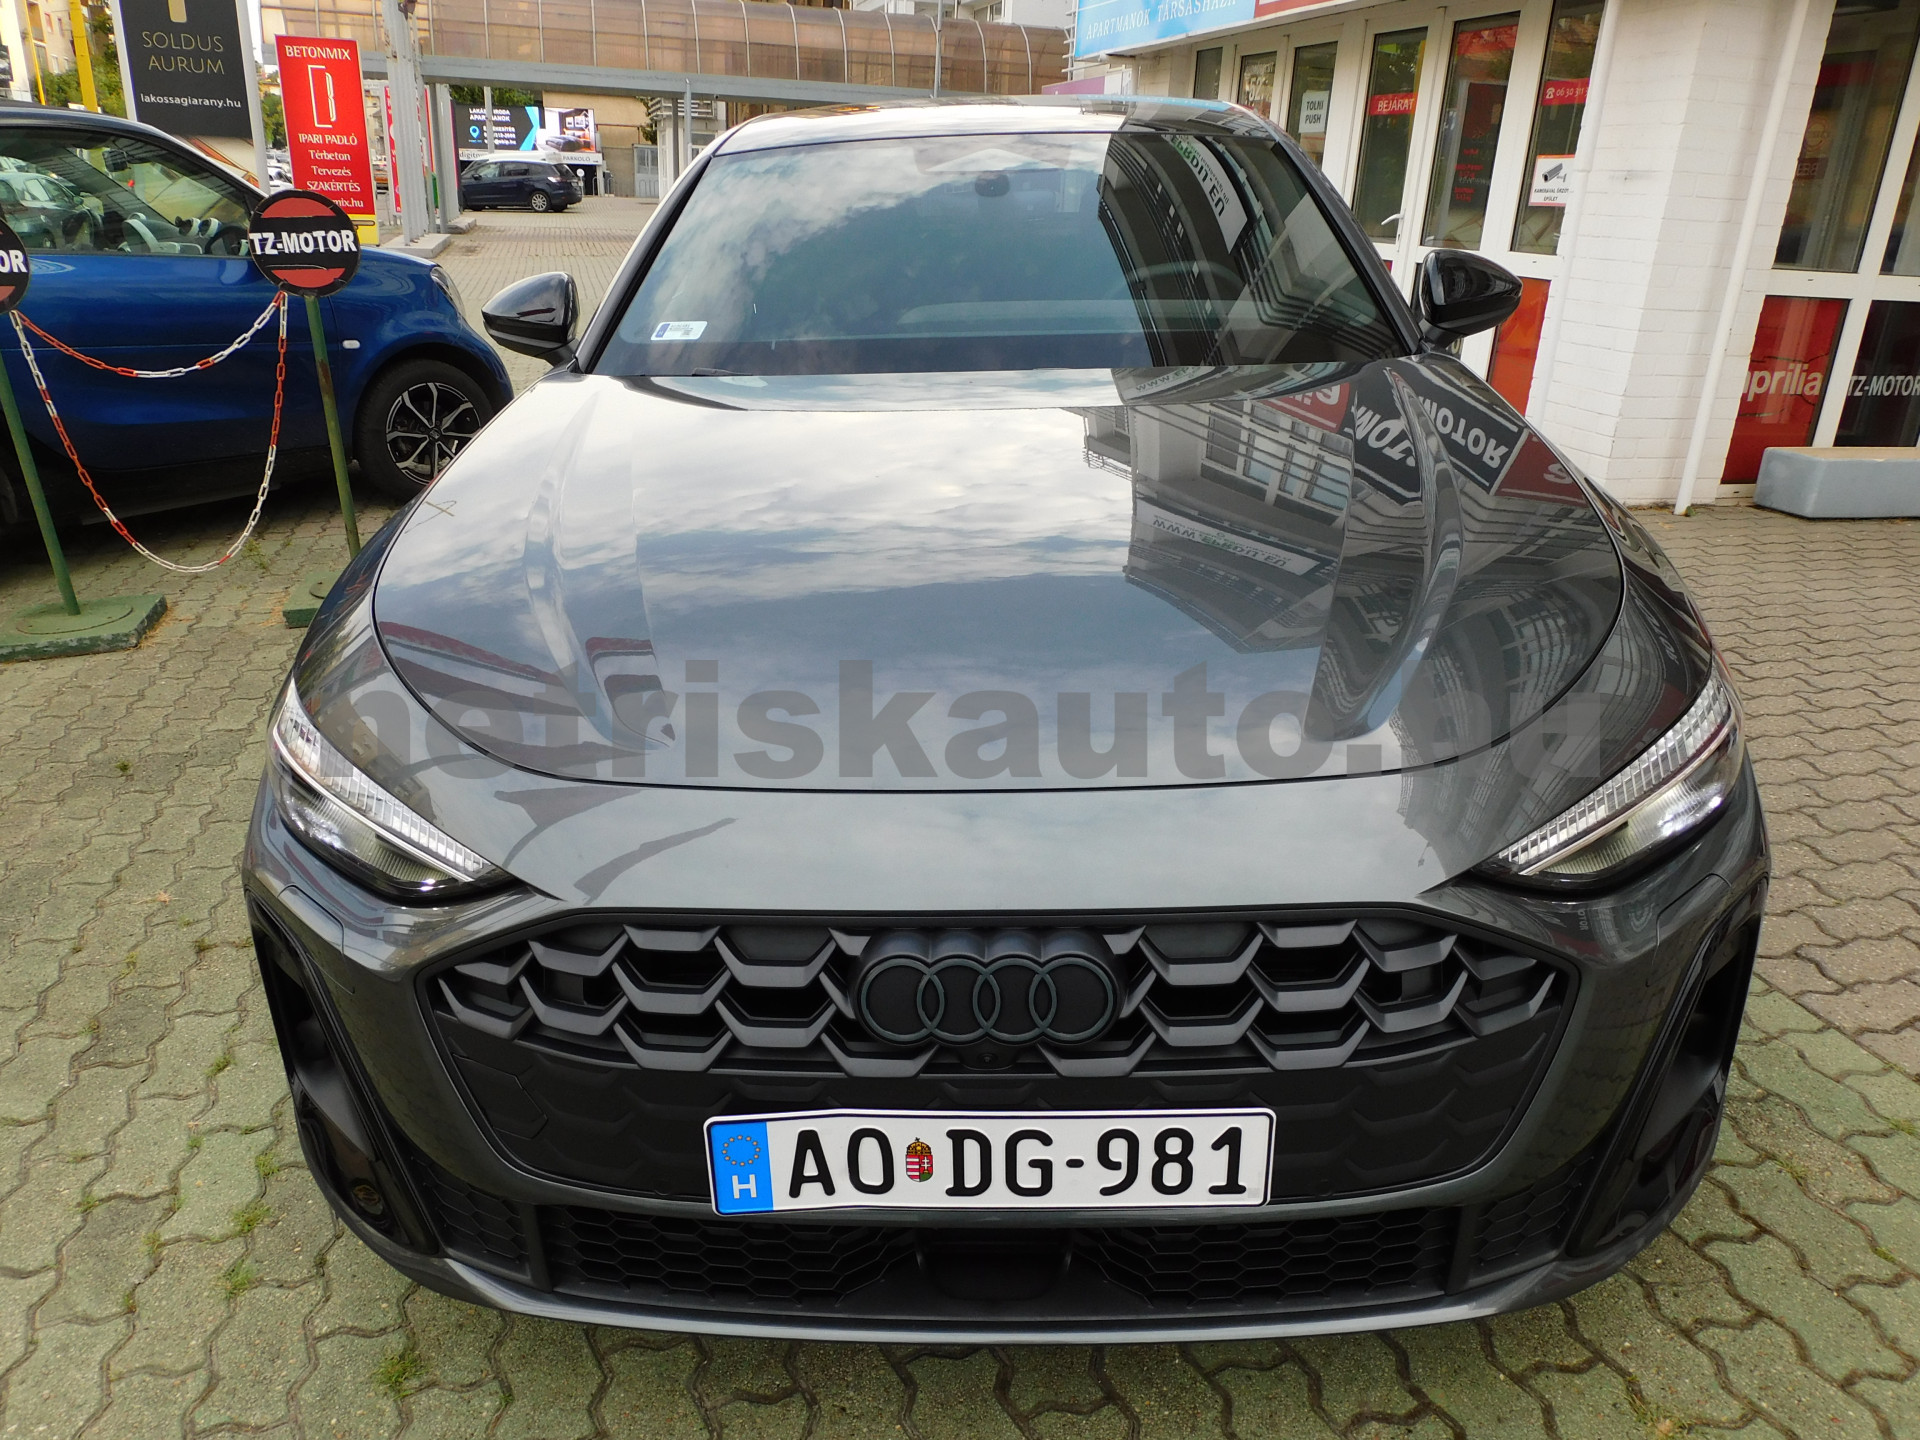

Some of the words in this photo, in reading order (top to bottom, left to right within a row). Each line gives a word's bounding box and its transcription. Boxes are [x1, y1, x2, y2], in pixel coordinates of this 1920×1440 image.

[1086, 9, 1151, 40] APARTMANOK
[142, 31, 224, 52] SOLDUS
[284, 44, 351, 61] BETONMIX
[148, 55, 225, 75] AURUM
[140, 93, 242, 109] lakossagiarany.hu
[1377, 97, 1415, 112] BEJÁRAT
[1304, 115, 1321, 125] PUSH
[298, 133, 323, 144] IPARI
[325, 133, 358, 146] PADLÓ
[308, 149, 351, 161] Térbeton
[311, 165, 352, 176] Tervezés
[306, 179, 361, 192] SZAKÉRTÉS
[250, 229, 358, 255] TZ-MOTOR
[789, 1127, 895, 1199] AO
[945, 1127, 1248, 1198] DG-981
[732, 1174, 757, 1199] H
